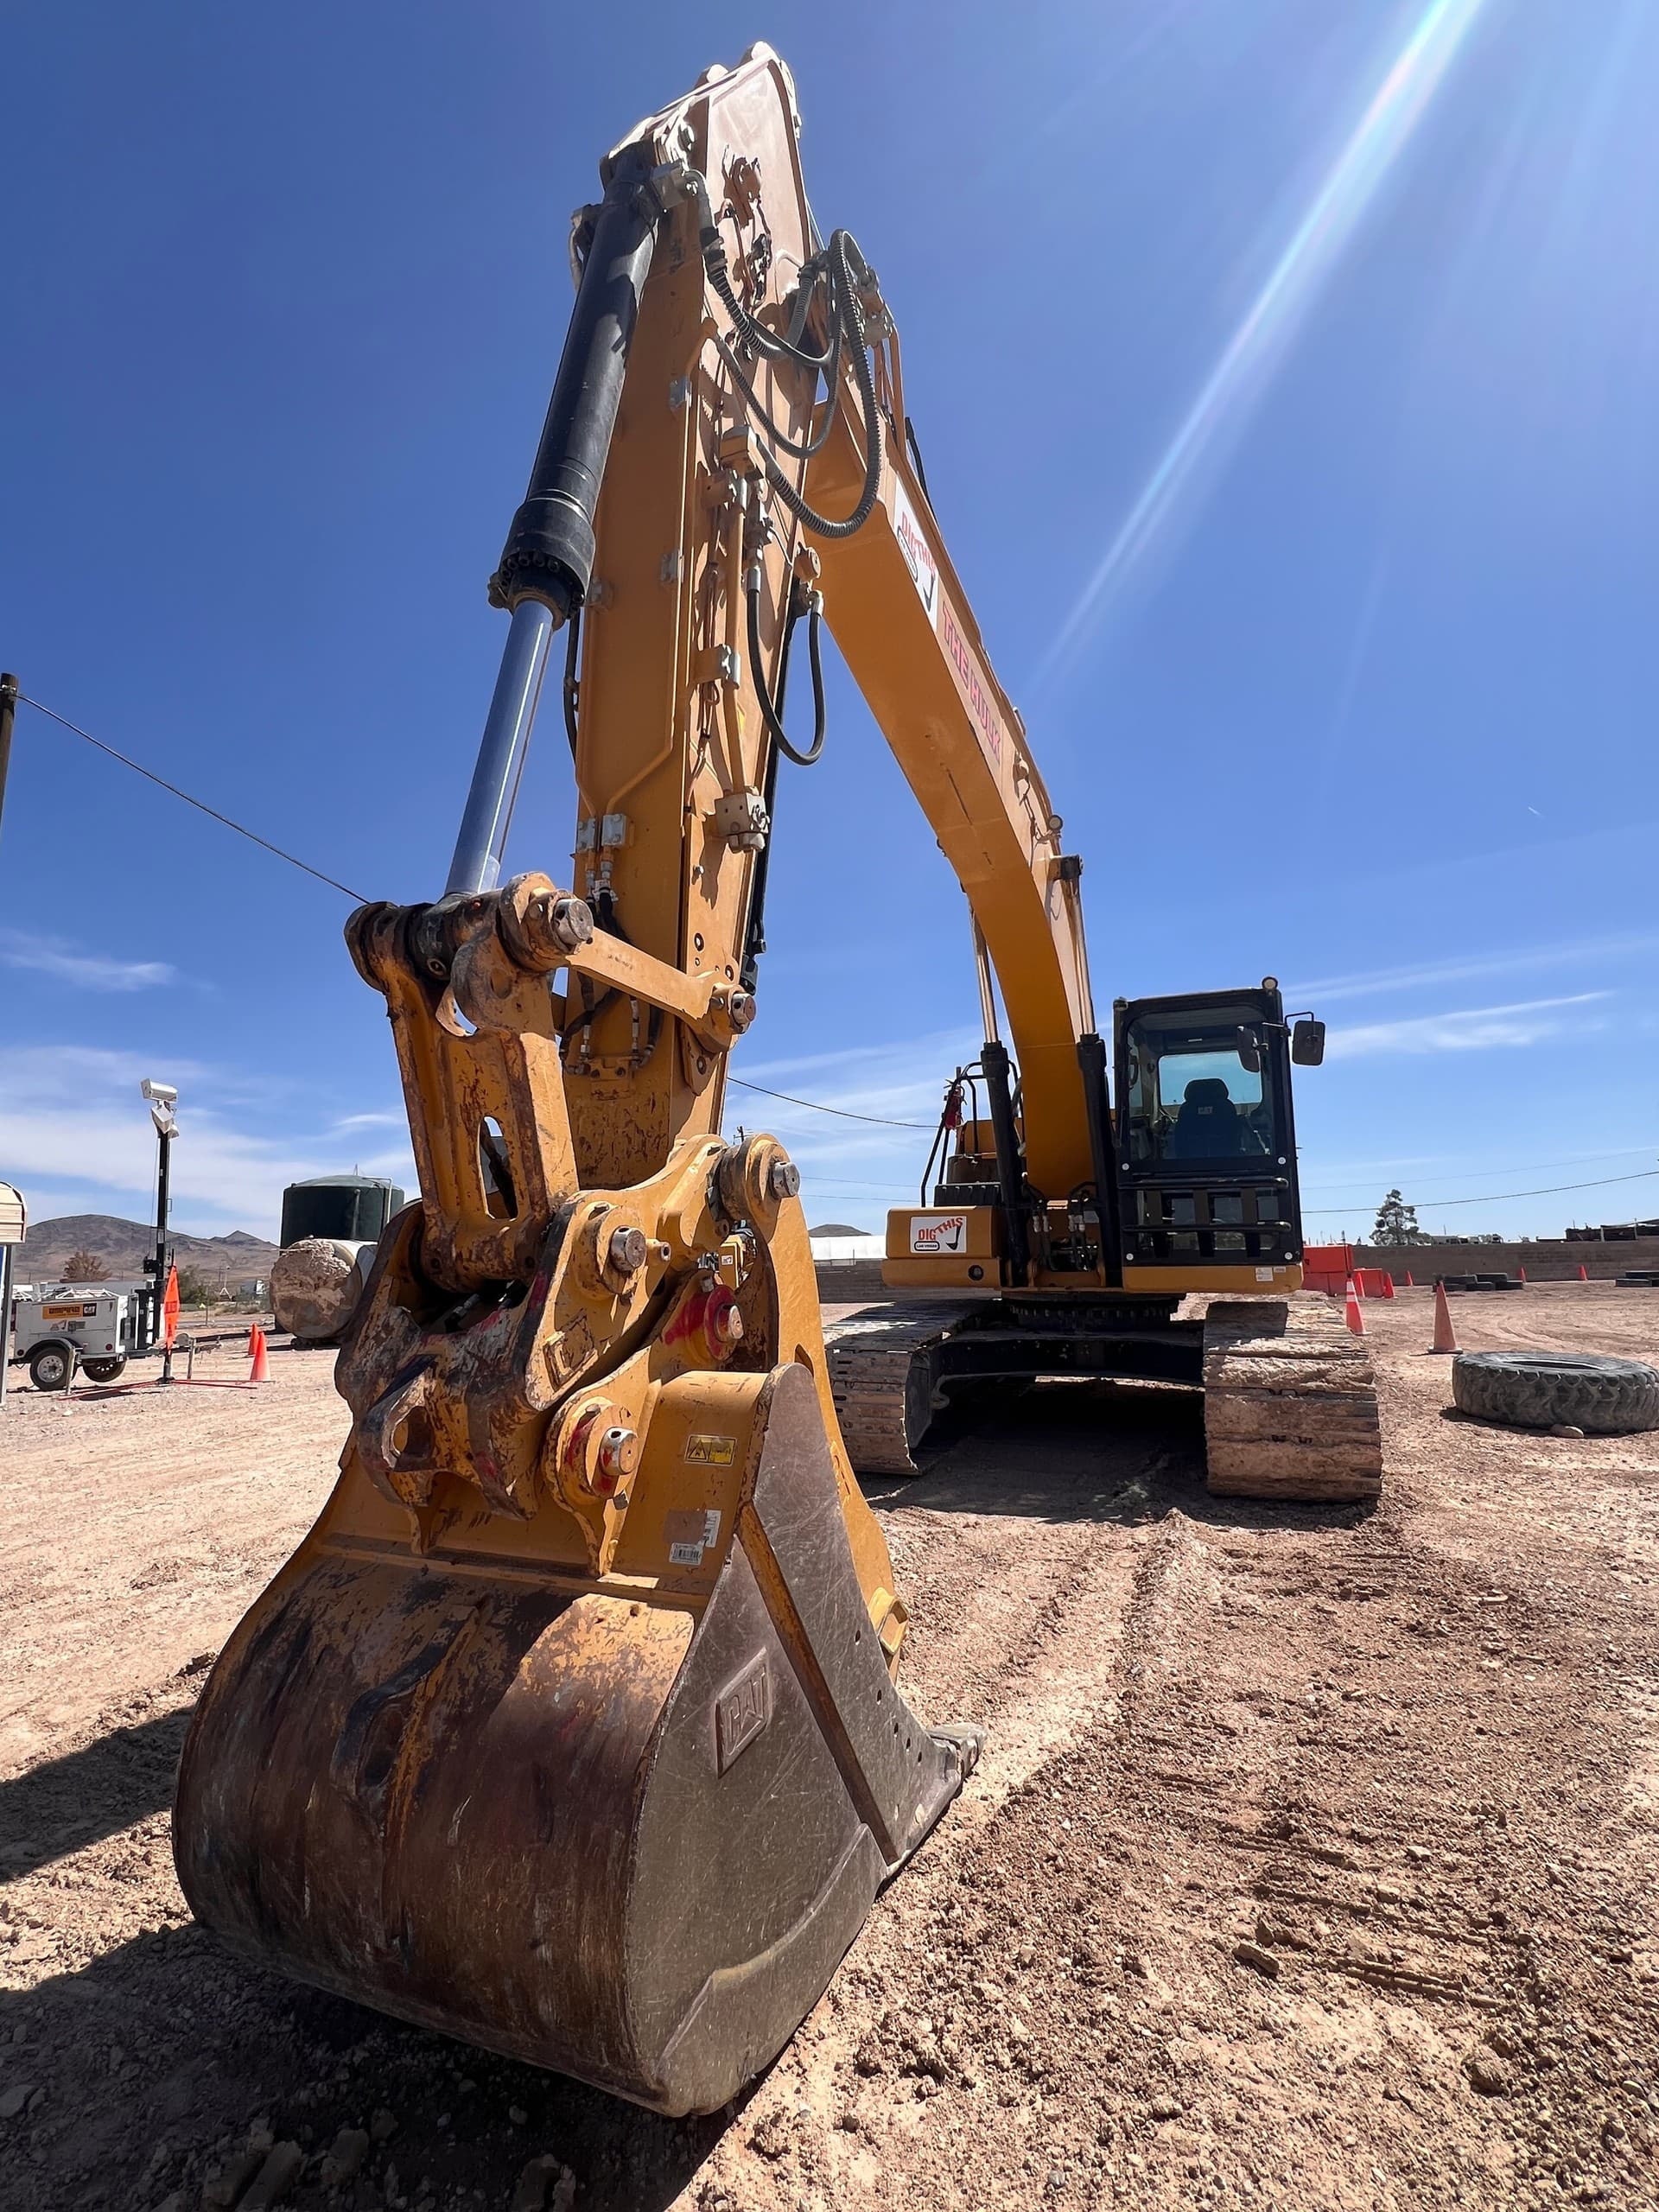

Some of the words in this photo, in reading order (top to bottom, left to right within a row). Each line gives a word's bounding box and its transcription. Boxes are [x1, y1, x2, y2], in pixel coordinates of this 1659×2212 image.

[943, 601, 969, 690] THE
[970, 669, 1001, 765] HULK
[918, 1228, 937, 1241] DIG
[933, 1217, 963, 1234] THIS
[83, 1306, 96, 1314] CAT
[725, 1662, 766, 1756] CAT
